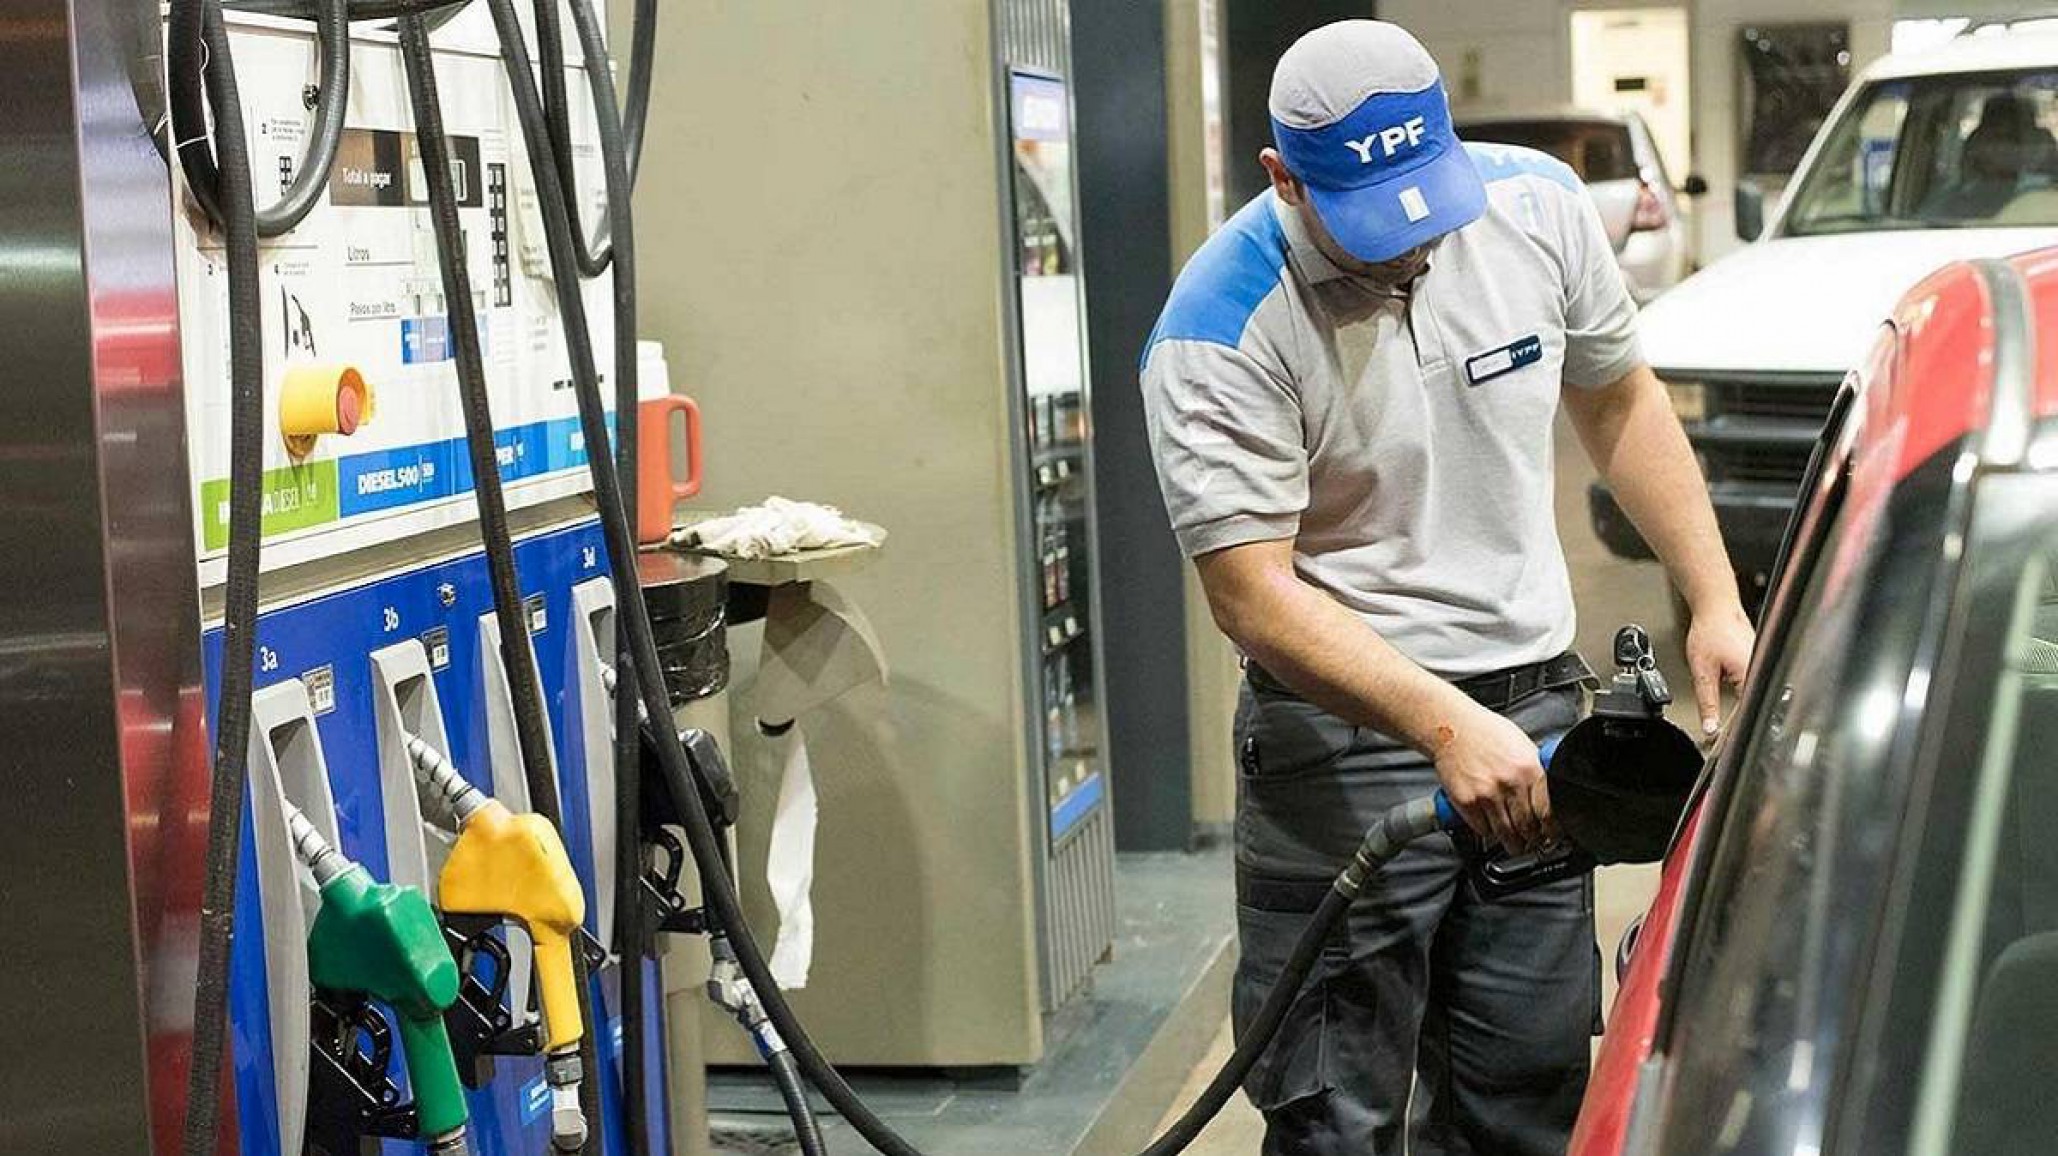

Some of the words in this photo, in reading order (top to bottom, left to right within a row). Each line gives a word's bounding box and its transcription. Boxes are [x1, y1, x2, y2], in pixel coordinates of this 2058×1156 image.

[1345, 115, 1426, 164] YPF
[342, 167, 362, 185] Total
[369, 172, 392, 189] pagar
[347, 246, 370, 261] Litros
[582, 546, 596, 569] 3d
[383, 607, 399, 632] 3b
[260, 645, 278, 672] 3a
